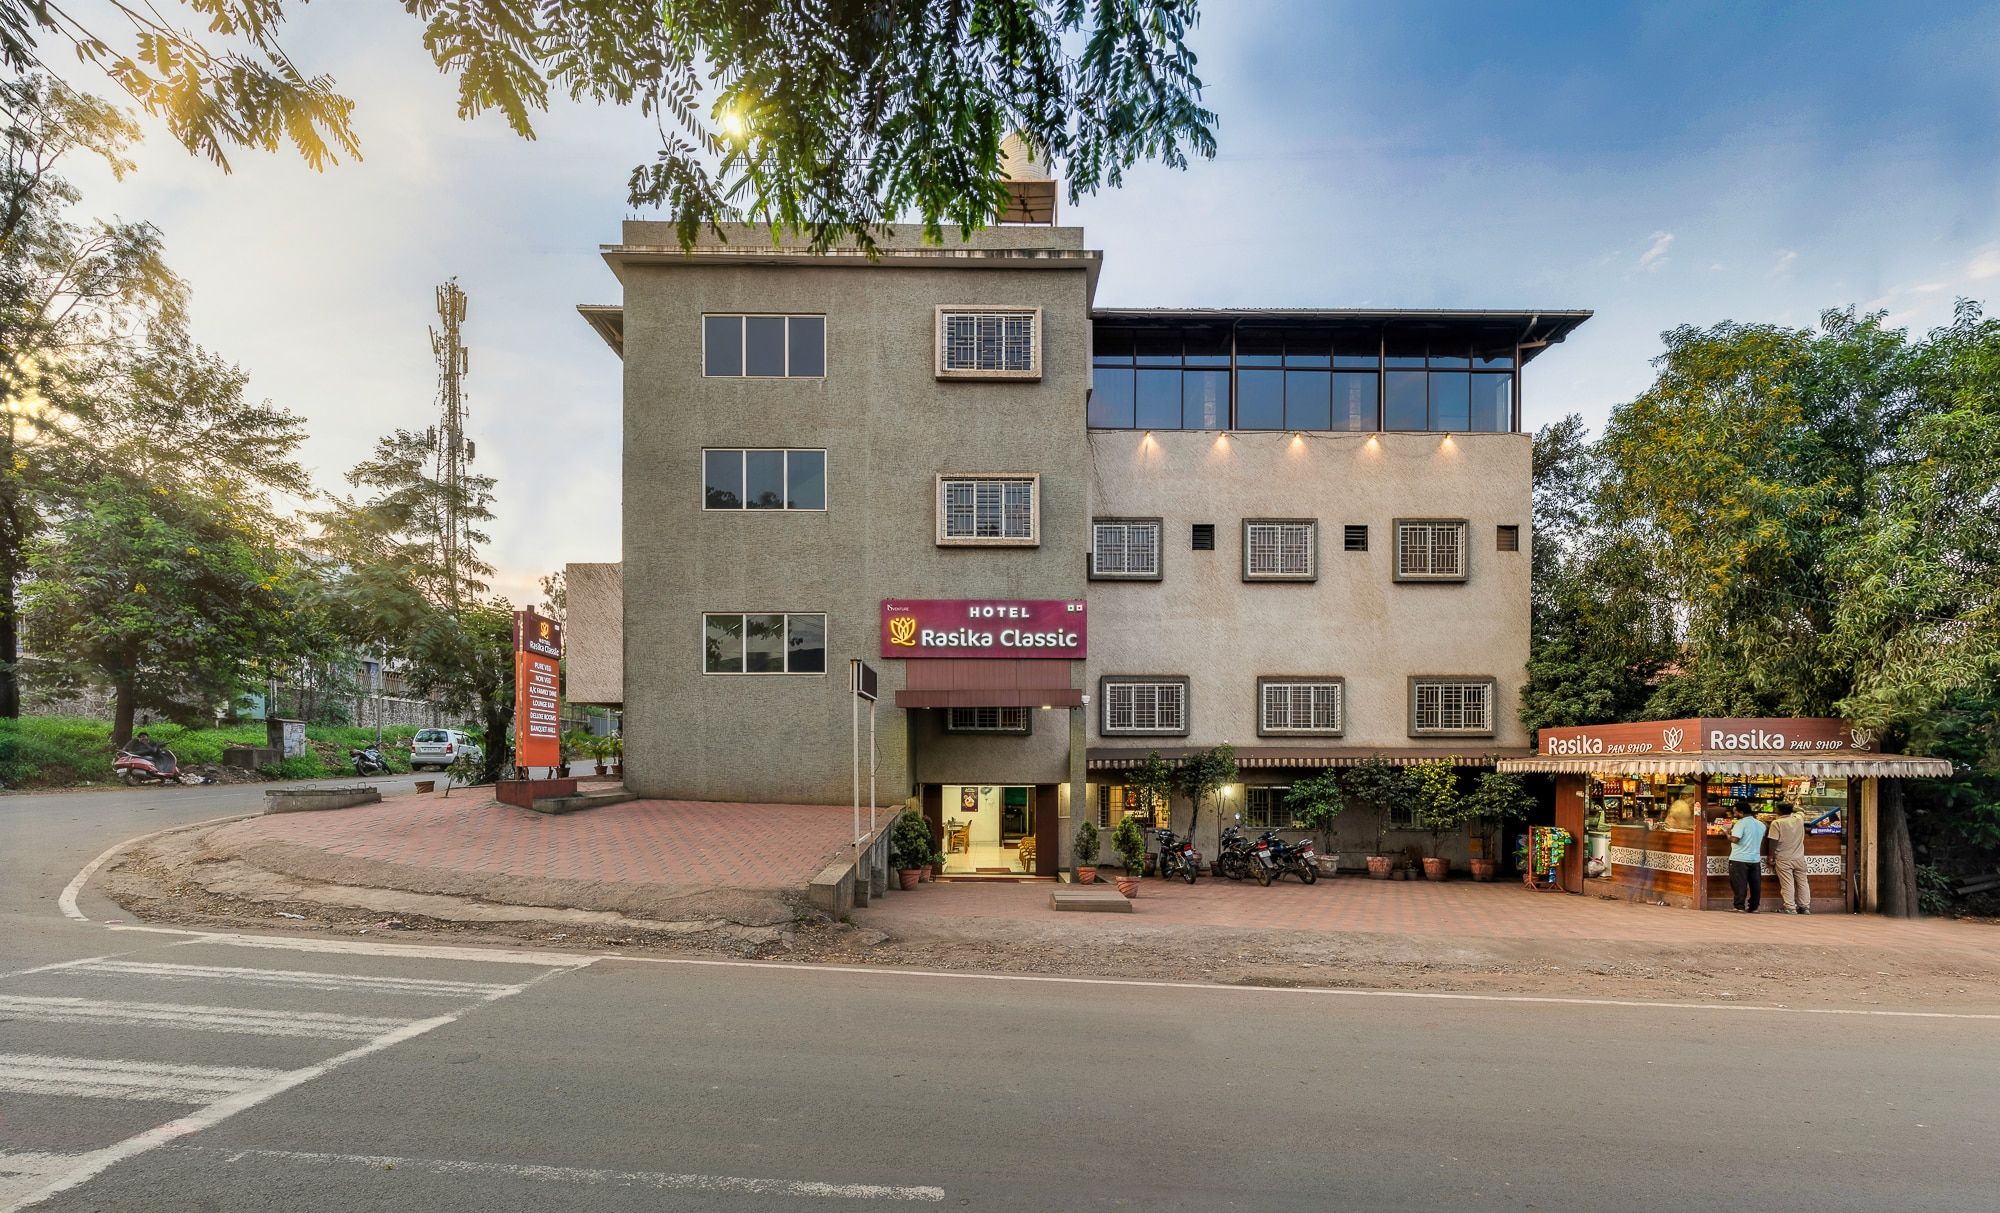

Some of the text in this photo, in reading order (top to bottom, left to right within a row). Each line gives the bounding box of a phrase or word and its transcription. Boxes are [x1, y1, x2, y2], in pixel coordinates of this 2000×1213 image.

[969, 606, 1030, 618] HOTEL
[921, 627, 1078, 647] Rasika Classic
[529, 640, 560, 657] Rasika Classic
[532, 699, 548, 708] LOUNGE
[530, 712, 544, 720] DELUXE
[530, 725, 548, 733] BANQUET
[1548, 734, 1653, 755] Rasika PAN SHOP
[1710, 729, 1843, 751] Rasika PAN SHOP
